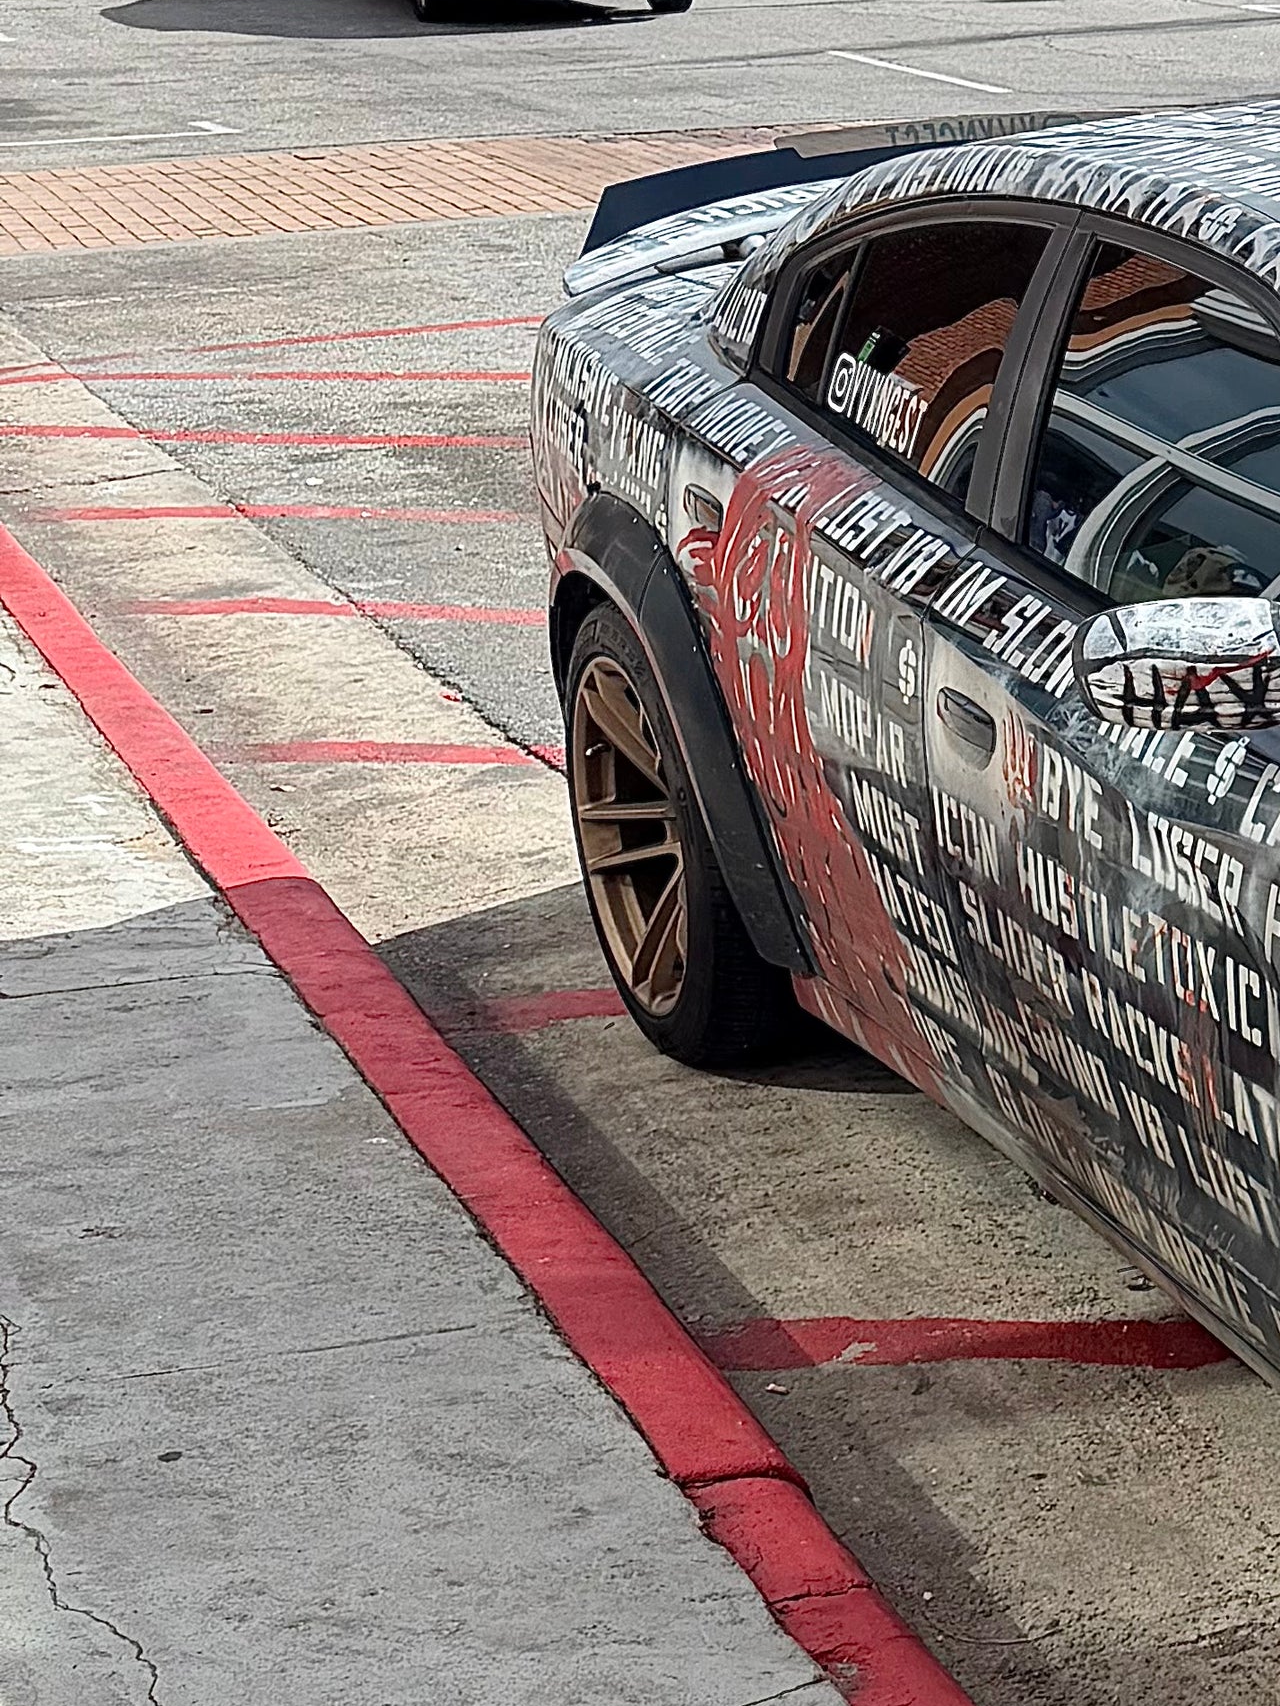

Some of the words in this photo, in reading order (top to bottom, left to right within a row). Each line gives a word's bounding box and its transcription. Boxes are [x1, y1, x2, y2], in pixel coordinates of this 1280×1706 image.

[689, 392, 798, 473] MONEY
[932, 559, 1009, 627] IM
[1039, 743, 1103, 851] BYE
[1125, 798, 1246, 939] LOSER
[1119, 1080, 1176, 1170] V8
